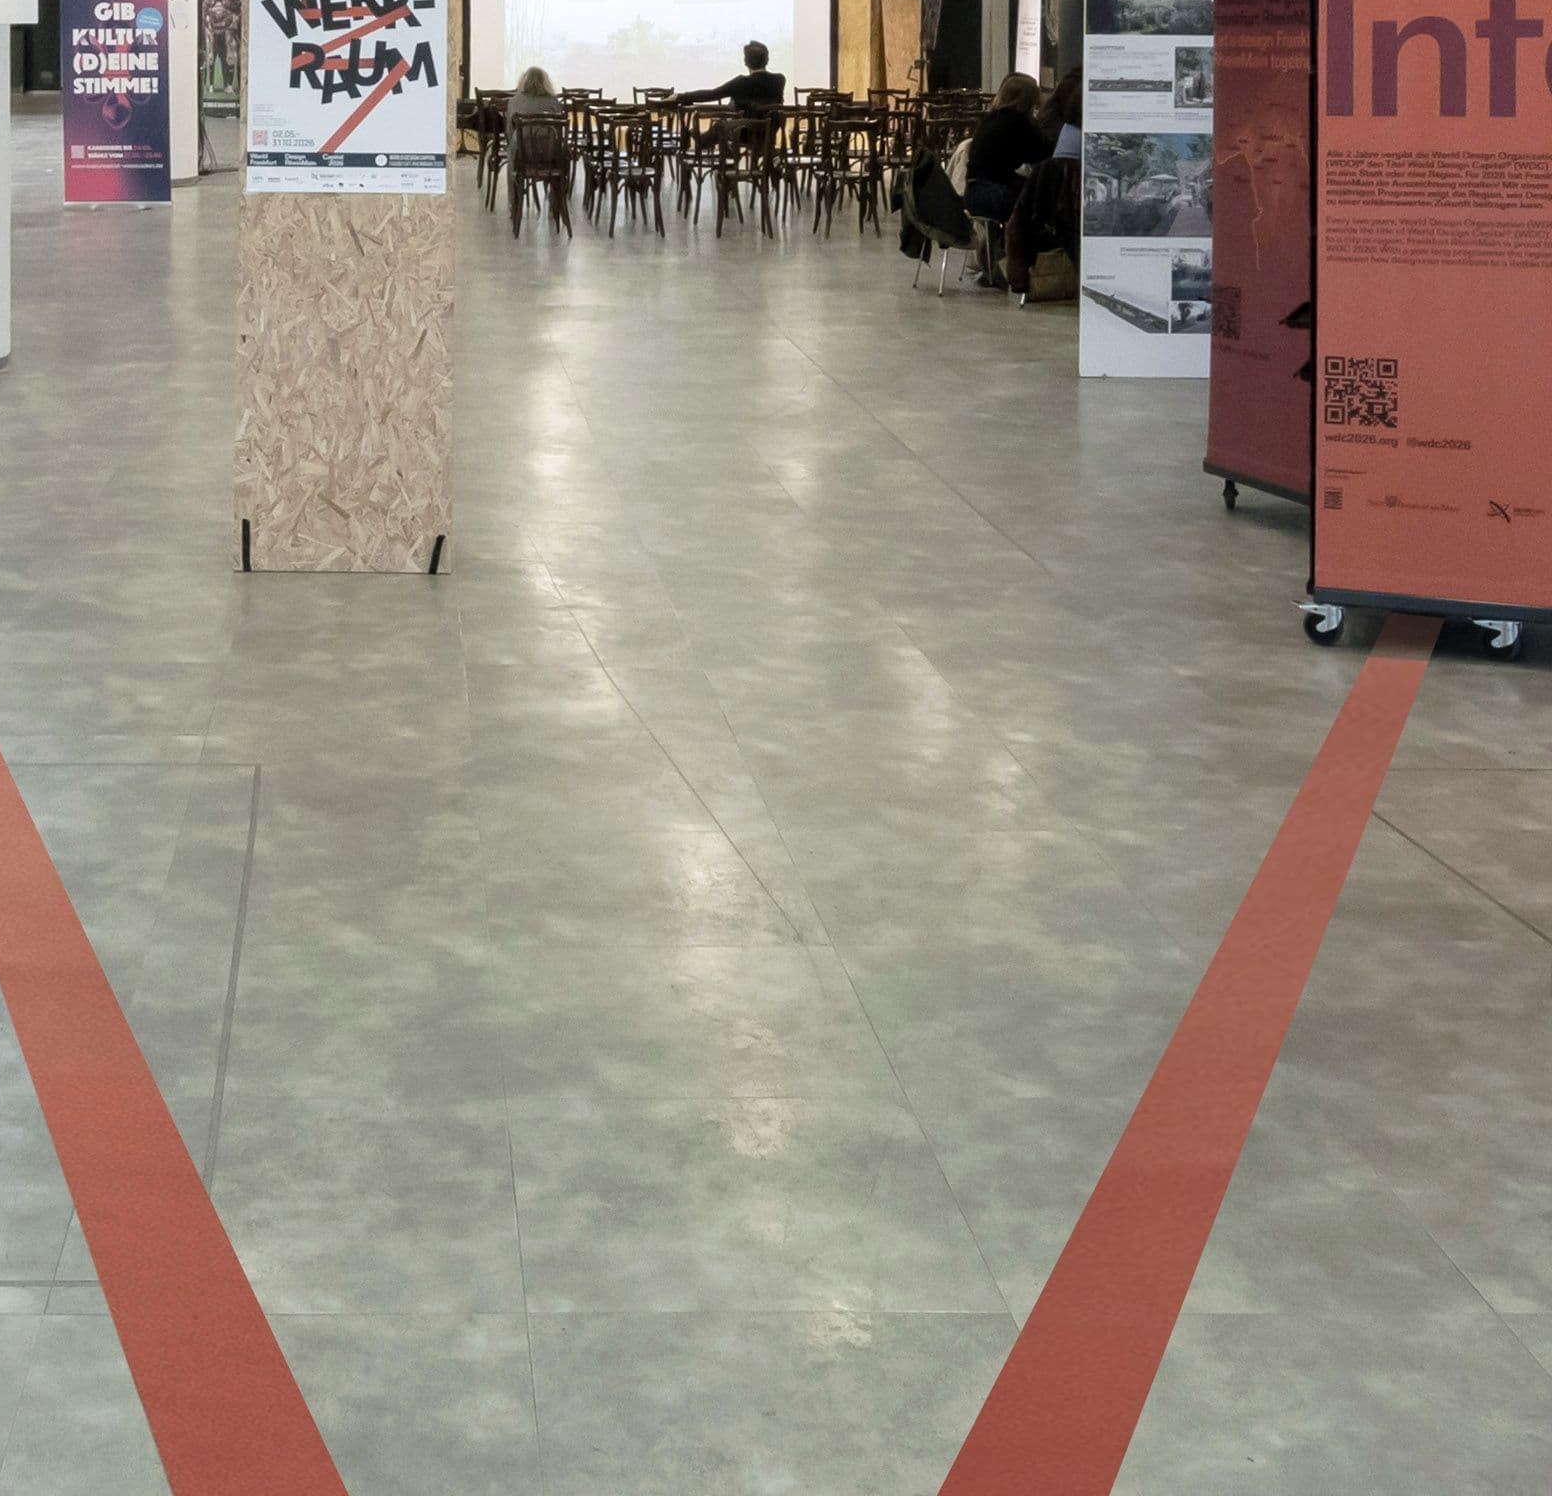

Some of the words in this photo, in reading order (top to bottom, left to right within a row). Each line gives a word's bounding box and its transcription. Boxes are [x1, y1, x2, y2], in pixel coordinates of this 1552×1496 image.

[94, 2, 136, 21] GIB
[72, 28, 158, 46] KULTUR
[72, 53, 159, 74] (D)EINE
[289, 39, 439, 104] RAUM
[73, 77, 158, 94] STIMME!
[1325, 433, 1398, 448] wdc2026.org
